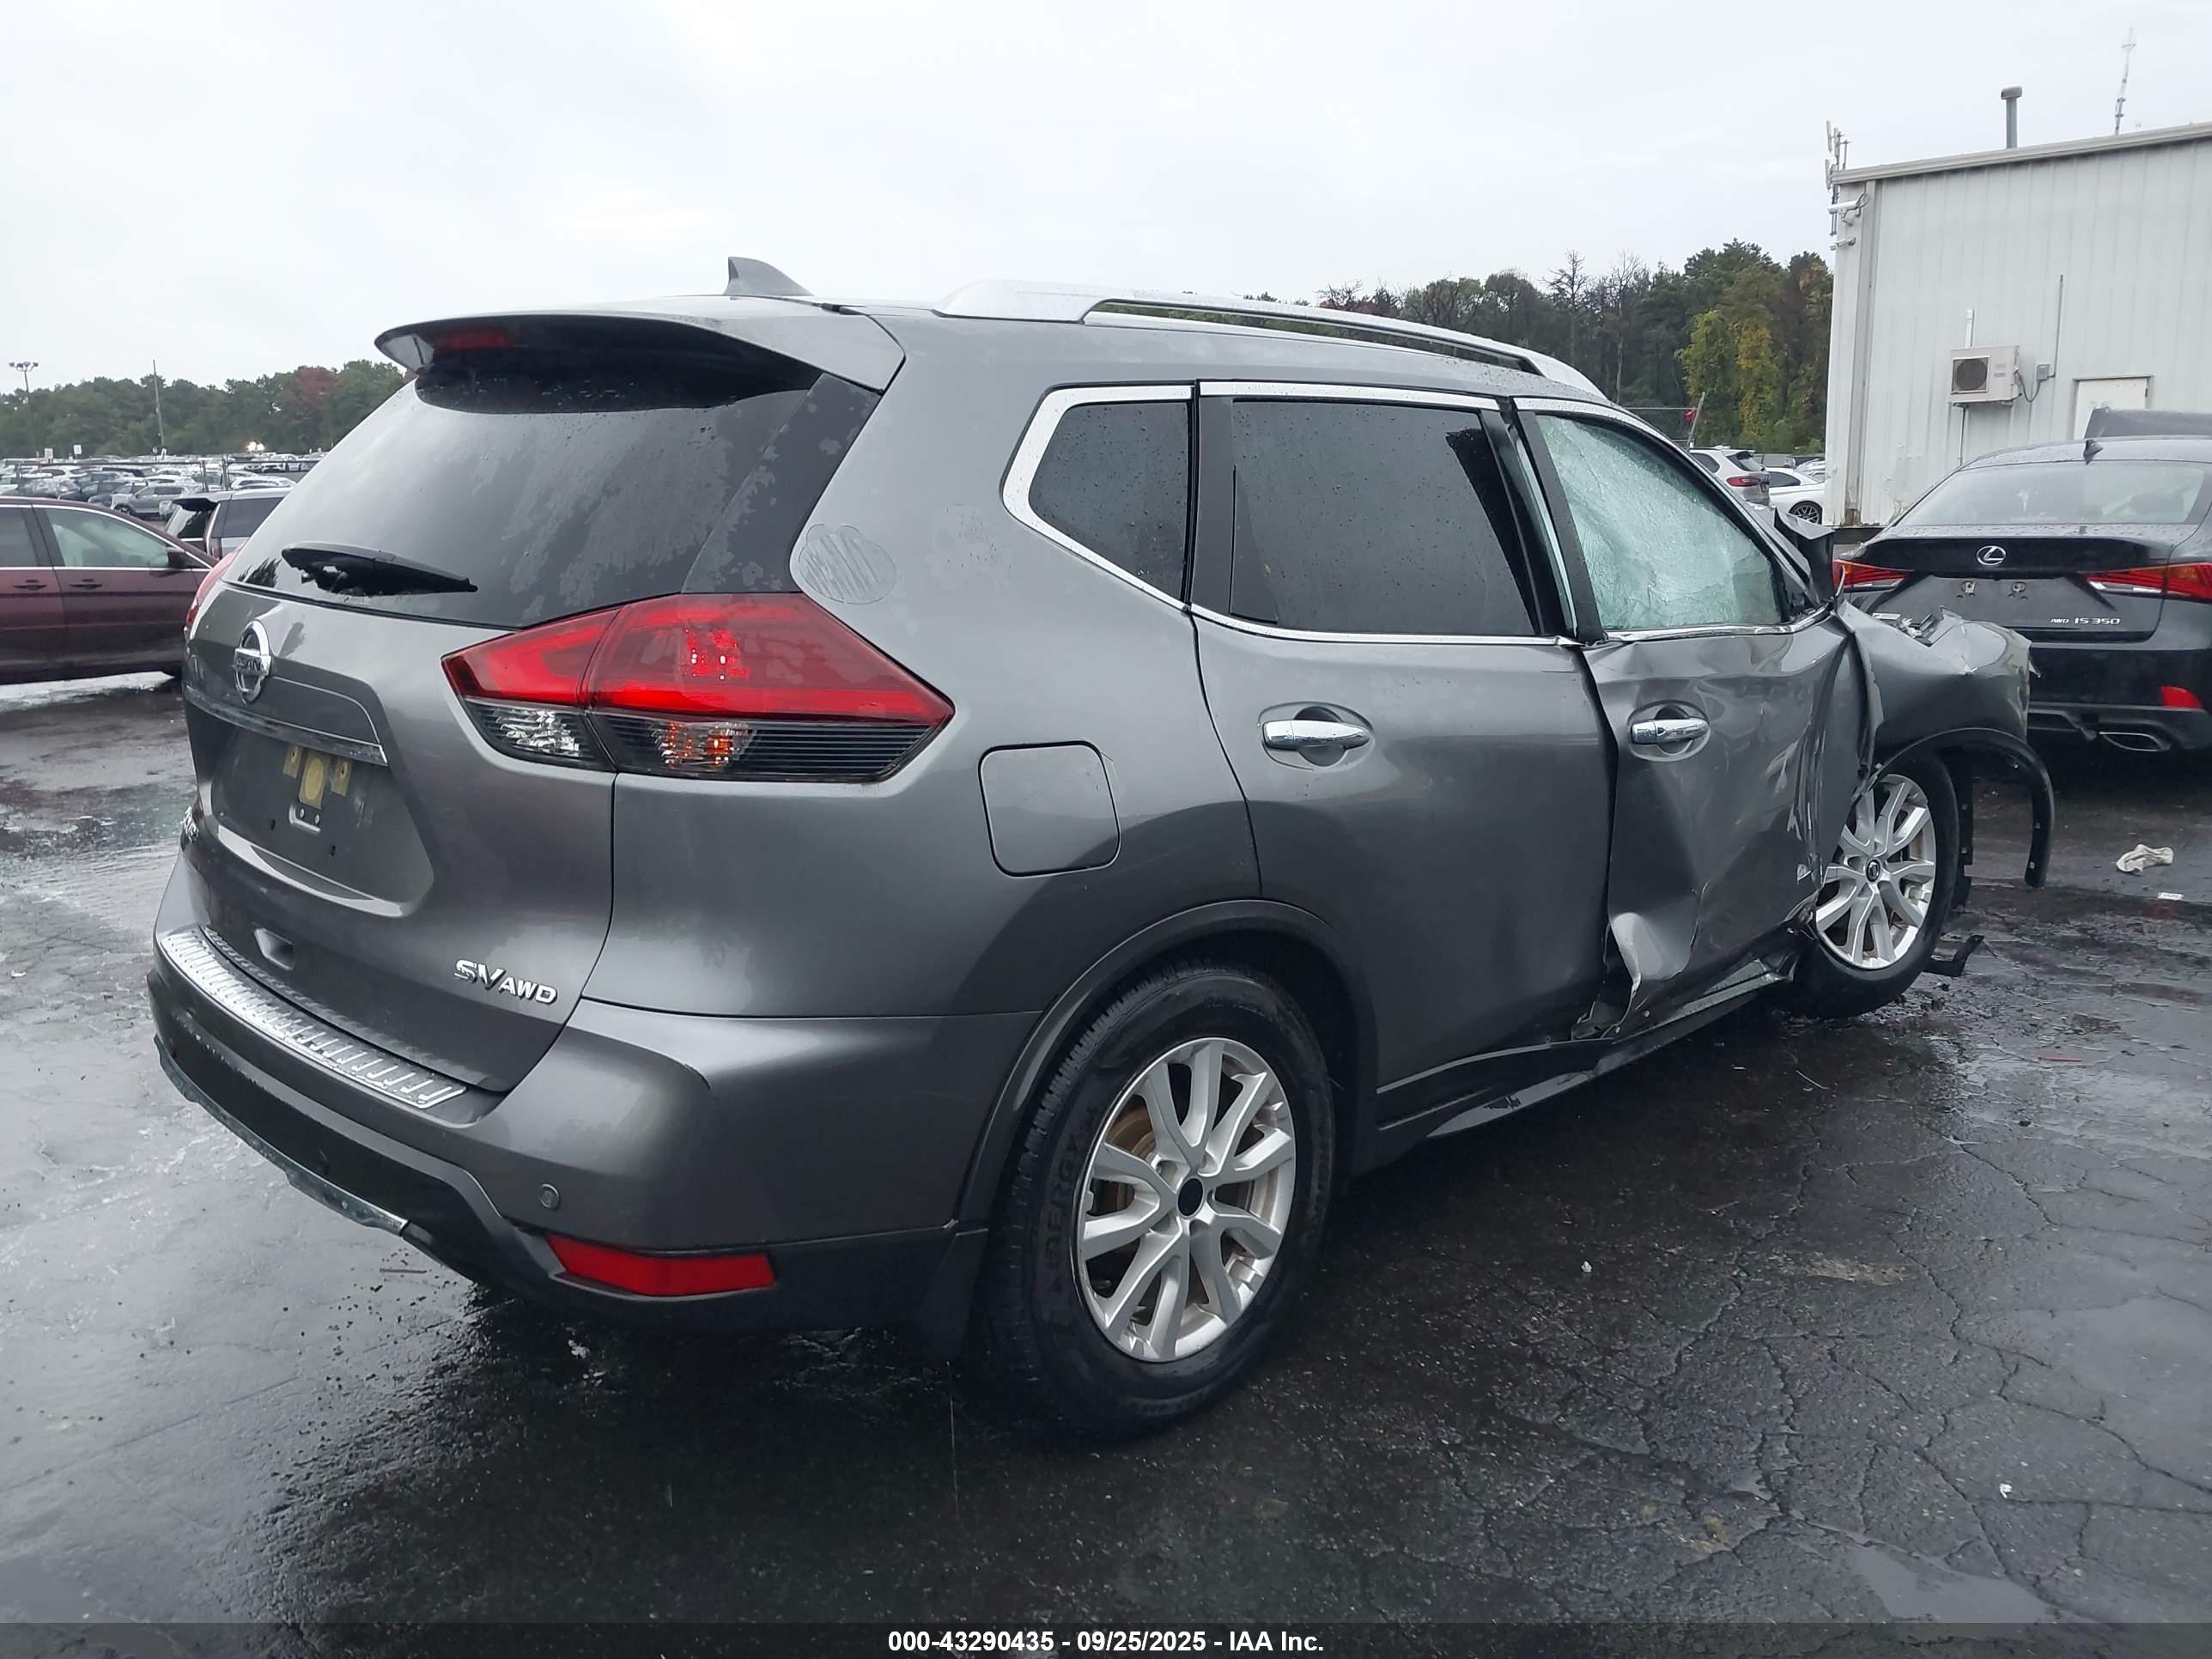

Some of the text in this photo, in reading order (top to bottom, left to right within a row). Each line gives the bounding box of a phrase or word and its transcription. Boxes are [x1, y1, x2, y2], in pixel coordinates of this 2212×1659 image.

[2074, 617, 2090, 625] IS
[2092, 617, 2121, 626] 350
[454, 959, 557, 1005] SV AWD
